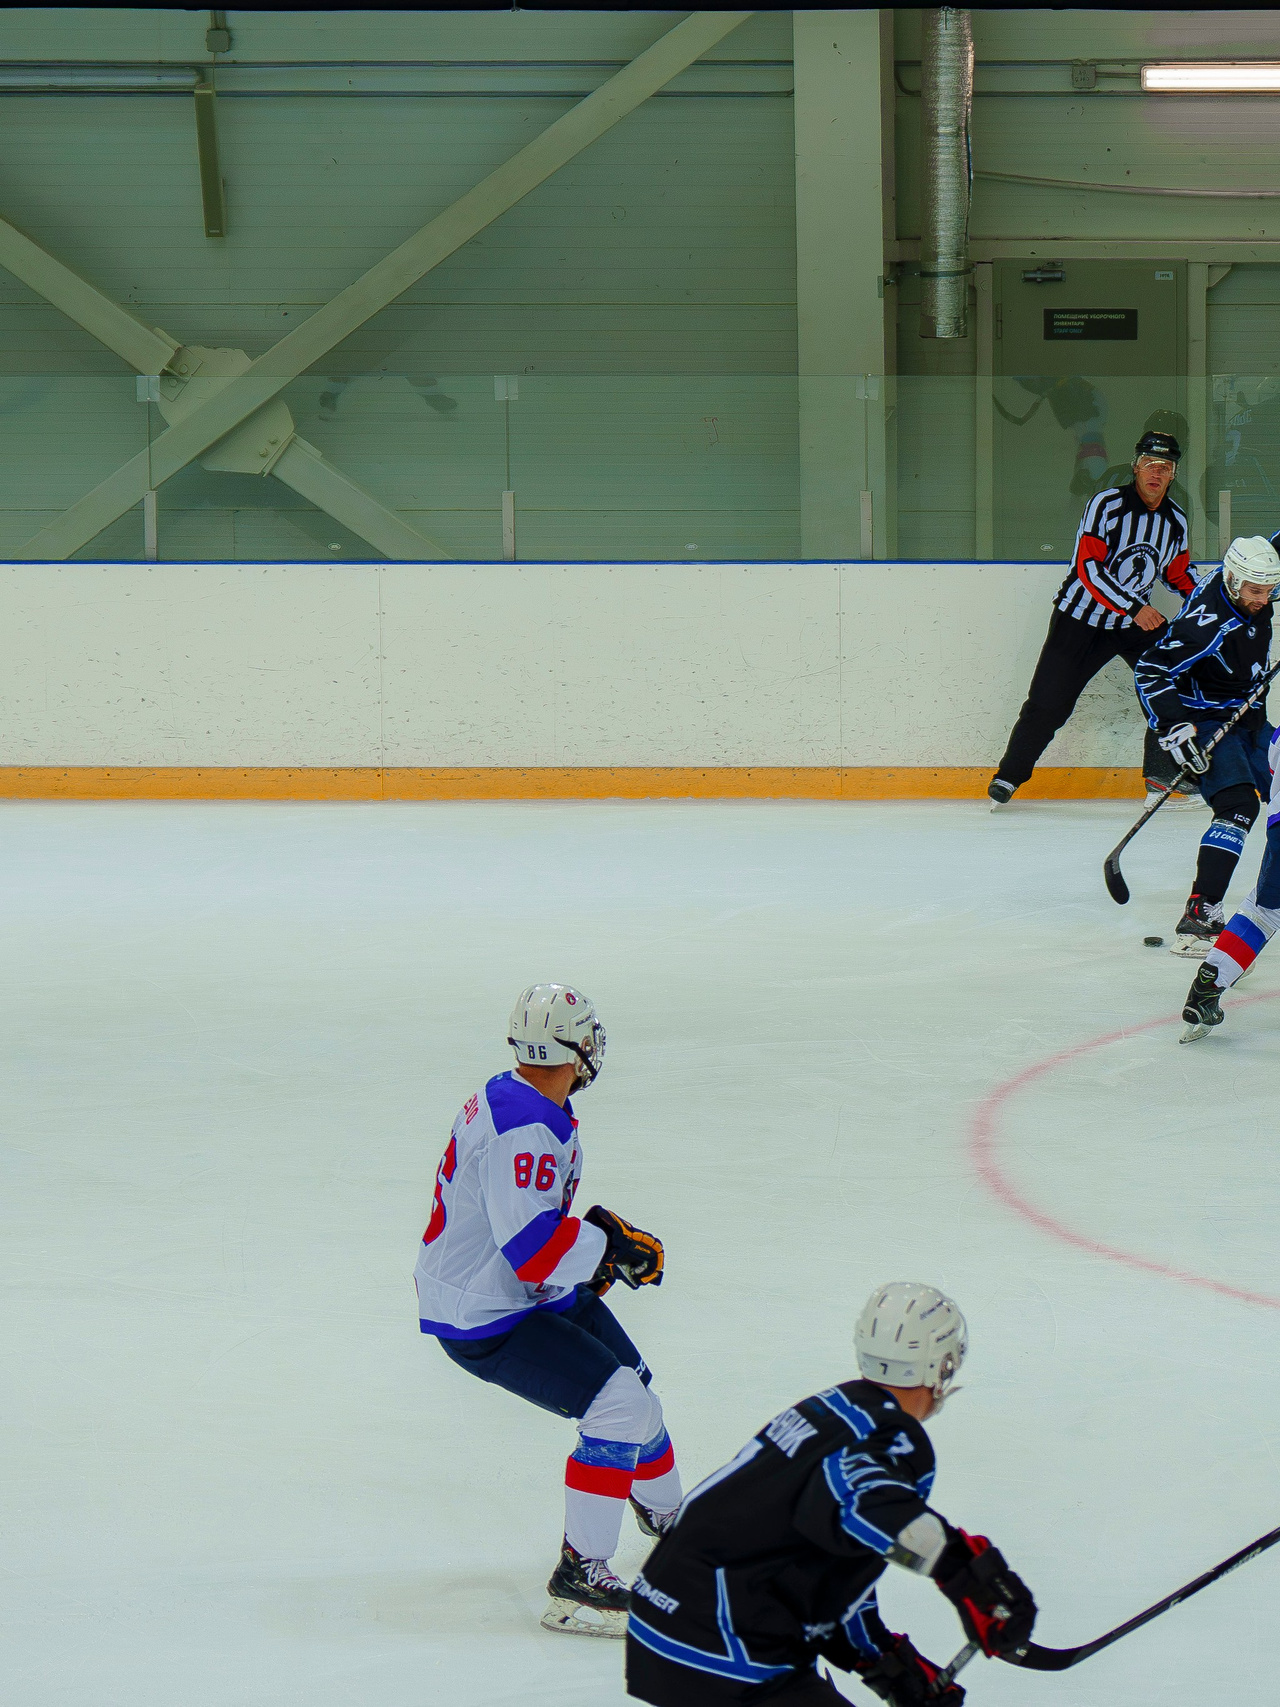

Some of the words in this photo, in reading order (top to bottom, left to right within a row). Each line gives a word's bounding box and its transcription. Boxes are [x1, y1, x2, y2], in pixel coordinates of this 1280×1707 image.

[527, 1044, 548, 1060] 86
[513, 1151, 557, 1192] 86
[879, 1362, 888, 1375] 7
